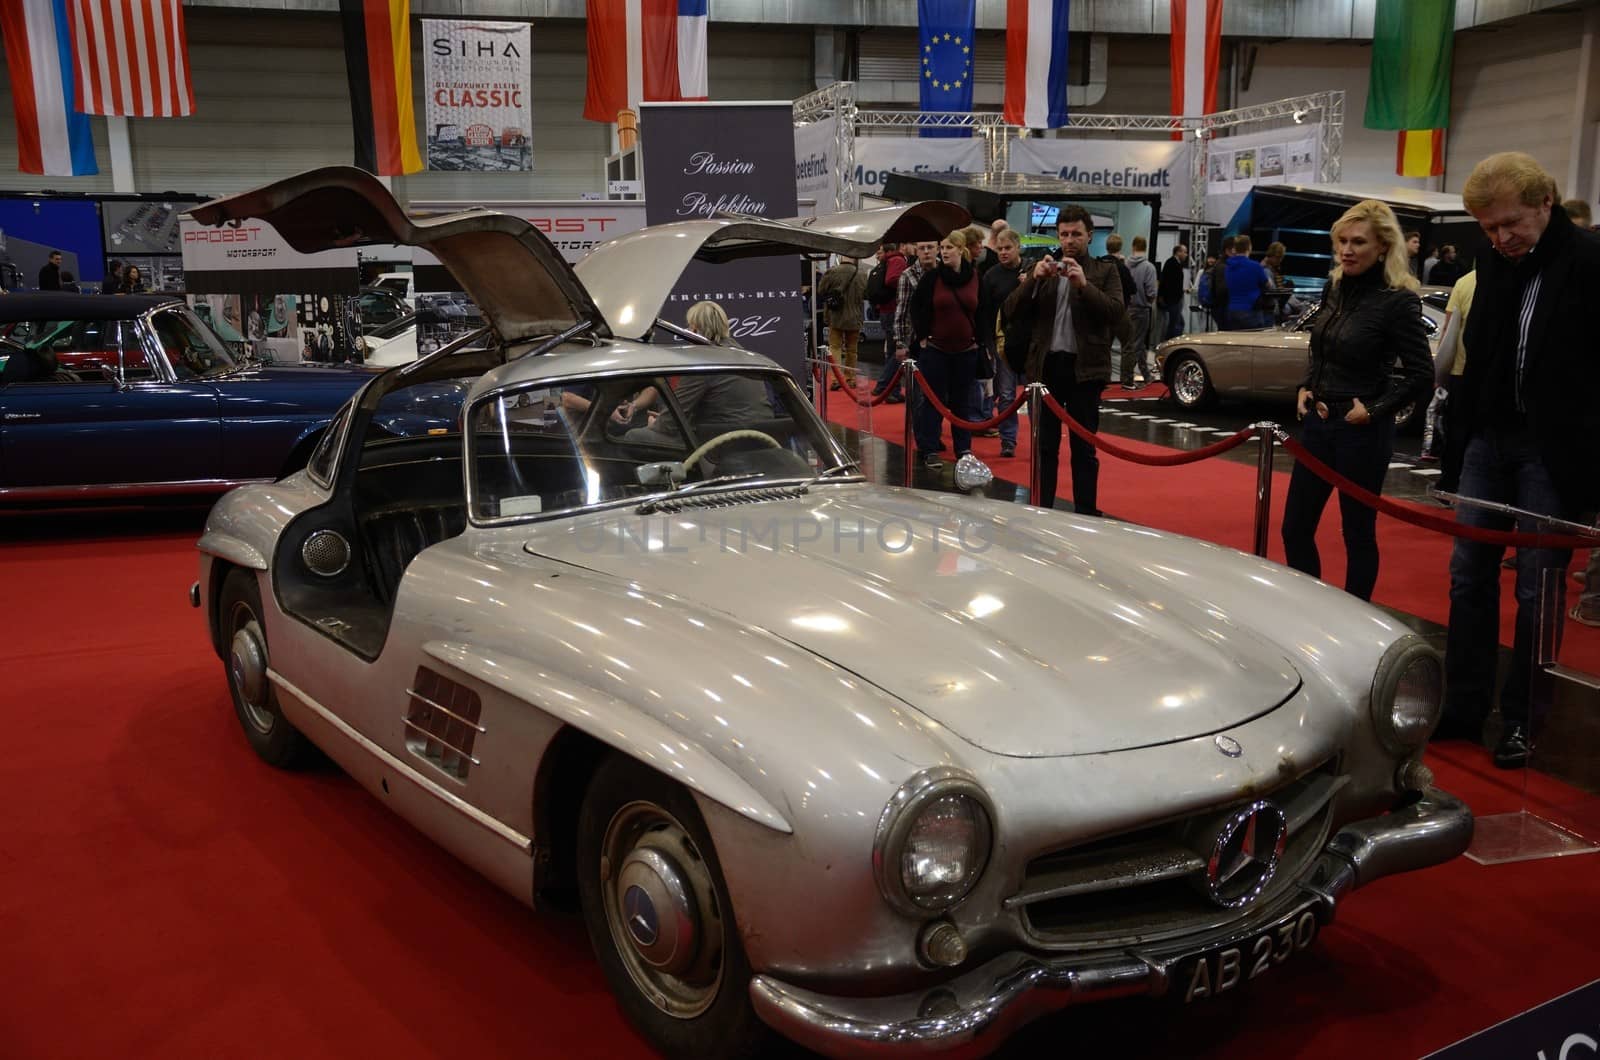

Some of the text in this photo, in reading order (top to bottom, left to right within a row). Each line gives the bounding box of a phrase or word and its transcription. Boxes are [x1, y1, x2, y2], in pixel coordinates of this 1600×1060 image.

[433, 38, 521, 58] SIHA
[434, 89, 523, 108] CLASSIC
[683, 151, 756, 176] Passion
[184, 228, 262, 244] PROBST
[227, 248, 278, 258] MOTORSPORT
[1185, 912, 1316, 1003] AB 230
